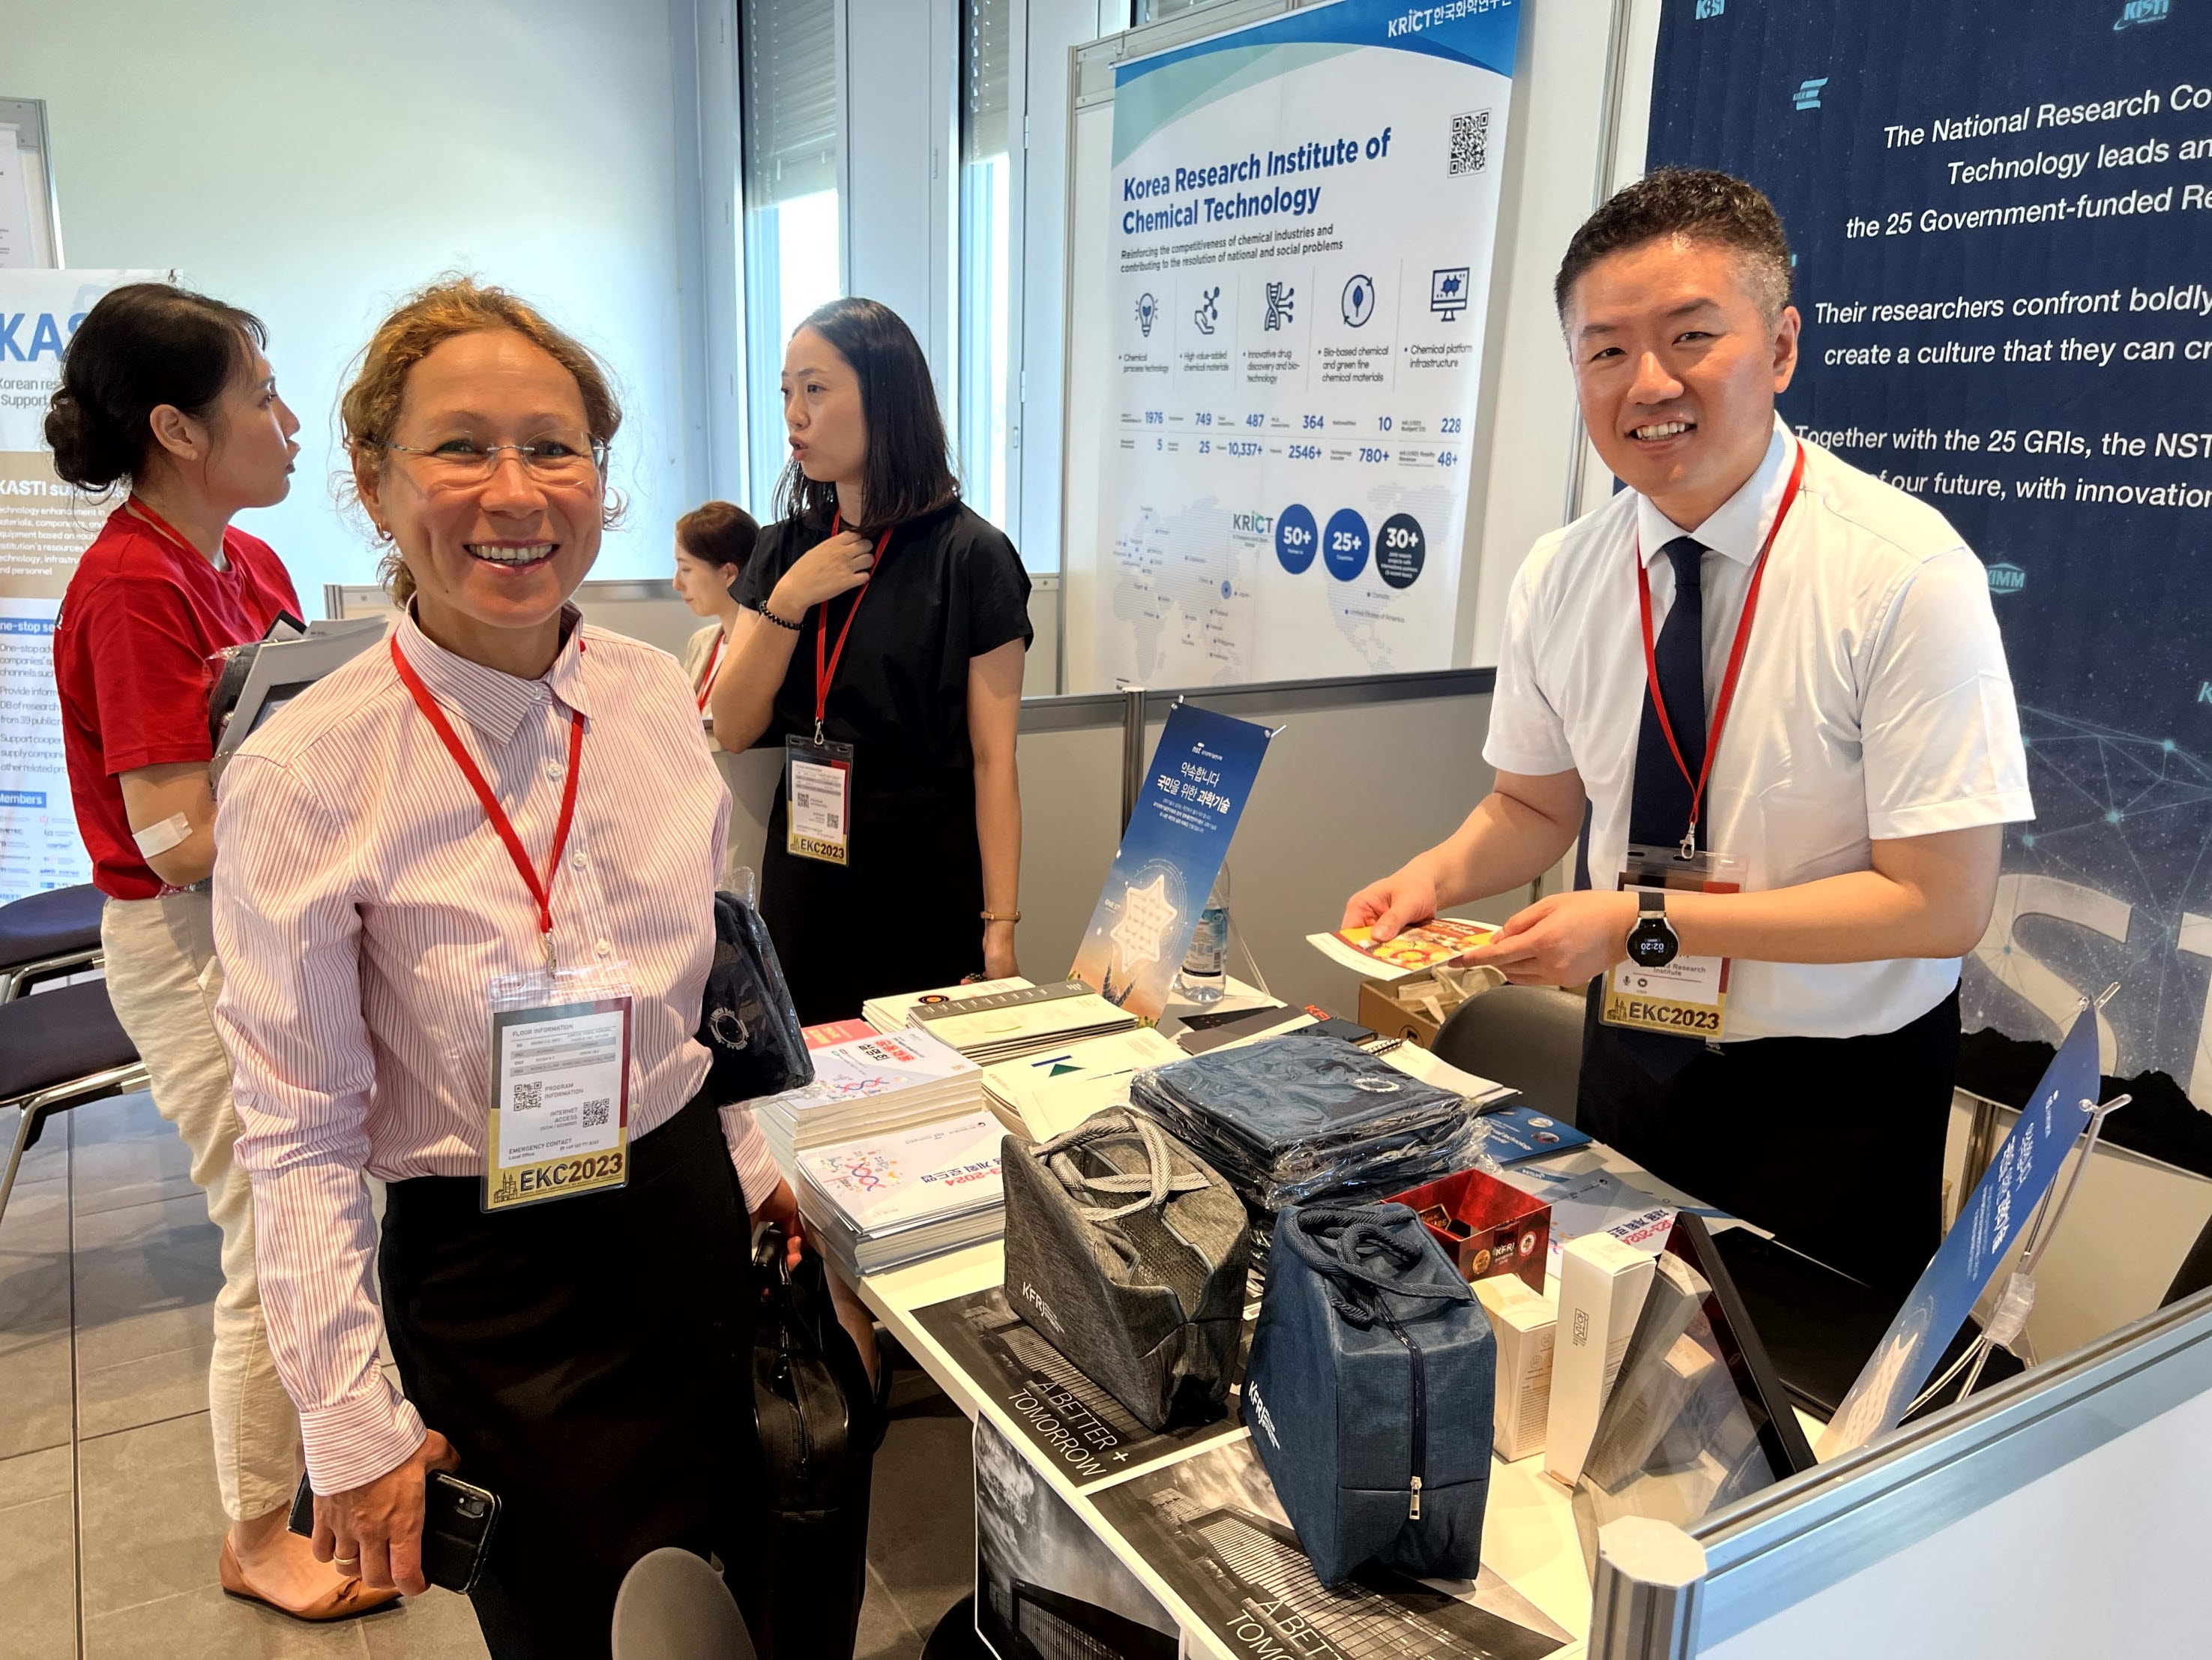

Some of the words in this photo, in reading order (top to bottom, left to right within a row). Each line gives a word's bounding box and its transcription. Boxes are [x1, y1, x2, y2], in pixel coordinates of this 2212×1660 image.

[1388, 8, 1432, 37] KRICT
[1884, 124, 1924, 149] The
[1932, 107, 2029, 143] National
[2037, 89, 2161, 129] Research
[2170, 84, 2212, 111] Co
[1124, 177, 1170, 202] Korea
[1175, 154, 1261, 193] Research
[1267, 139, 1358, 177] Institute
[1366, 127, 1391, 160] of
[1947, 149, 2090, 185] Technology
[2097, 138, 2170, 169] leads
[2178, 139, 2212, 160] an
[1123, 199, 1199, 235] Chemical
[1204, 187, 1322, 223] Technology
[1846, 216, 1879, 239] the
[1885, 211, 1913, 235] 25
[1920, 187, 2173, 232] Government-funded
[2181, 184, 2212, 210] Re
[1121, 247, 1158, 259] Reinforcing
[1160, 244, 1170, 256] the
[1172, 238, 1227, 255] competitiveness
[1228, 235, 1236, 247] of
[1238, 231, 1273, 245] chemical
[1274, 226, 1315, 241] industries
[1317, 223, 1334, 236] and
[1121, 260, 1161, 274] contributing
[1162, 259, 1169, 268] to
[1170, 256, 1181, 268] the
[1182, 253, 1217, 266] resolution
[1218, 251, 1226, 262] of
[1227, 248, 1258, 261] national
[1259, 245, 1275, 258] and
[1277, 242, 1301, 256] social
[1303, 238, 1343, 255] problems
[1815, 301, 1868, 325] Their
[1872, 298, 2004, 322] researchers
[2012, 289, 2123, 316] confront
[2129, 285, 2212, 316] boldly
[1324, 347, 1357, 358] Bio-based
[1358, 346, 1390, 356] chemical
[1411, 343, 1445, 355] Chemical
[1446, 343, 1473, 356] platform
[1824, 343, 1892, 366] create
[1897, 347, 1910, 364] a
[1917, 341, 1995, 365] culture
[2004, 339, 2052, 363] that
[2060, 337, 2116, 367] they
[2123, 339, 2175, 361] can
[2184, 340, 2212, 360] cr
[1322, 361, 1336, 370] and
[1336, 361, 1356, 371] green
[1357, 360, 1369, 370] fine
[1409, 358, 1459, 369] infrastructure
[1322, 373, 1351, 383] chemical
[1352, 372, 1384, 382] materials
[1, 395, 48, 409] Support
[1145, 412, 1163, 424] 1976
[1195, 412, 1212, 426] 749
[1246, 414, 1265, 428] 487
[1302, 415, 1325, 430] 364
[1378, 417, 1393, 432] 10
[1440, 418, 1462, 433] 228
[1157, 439, 1163, 451] 5
[1199, 441, 1211, 454] 25
[1228, 442, 1263, 458] 10,337+
[1893, 428, 1938, 450] with
[1944, 429, 1980, 451] the
[1987, 430, 2016, 452] 25
[2024, 430, 2091, 459] GRIs,
[2102, 431, 2146, 457] the
[2154, 433, 2212, 459] NST
[1288, 445, 1322, 460] 2546+
[1359, 448, 1390, 463] 780+
[1437, 451, 1458, 467] 48+
[1891, 473, 1928, 493] our
[1933, 472, 2007, 502] future,
[2015, 476, 2066, 500] with
[1232, 510, 1274, 535] KRICT
[1283, 526, 1312, 546] 50+
[1331, 532, 1362, 552] 25+
[1385, 527, 1419, 549] 30+
[0, 715, 19, 725] from
[0, 733, 33, 745] Support
[1180, 761, 1221, 788] 약속합니다
[1157, 774, 1181, 796] 국민을
[1180, 783, 1199, 802] 위한
[1196, 790, 1231, 814] 과학기술
[800, 837, 845, 859] EKC2023
[1640, 942, 1664, 951] 02:20
[1653, 967, 1682, 976] Institute
[1672, 963, 1707, 974] Research
[1629, 1002, 1720, 1030] EKC2023
[512, 1029, 533, 1037] FLOOR
[534, 1023, 574, 1035] INFORMATION
[544, 1082, 574, 1092] PROGRAM
[544, 1088, 584, 1099] INFORMATION
[549, 1107, 578, 1116] INTERNET
[554, 1114, 578, 1123] ACCESS
[509, 1143, 546, 1155] EMERGENCY
[546, 1138, 573, 1148] CONTACT
[520, 1152, 623, 1193] EKC2023
[944, 1167, 1002, 1187] 3-2024
[1495, 1242, 1515, 1257] KFRI
[1036, 1381, 1059, 1394] A
[1049, 1392, 1118, 1451] BETTER
[1007, 1388, 1107, 1476] TOMORROW
[1256, 1599, 1285, 1617] A
